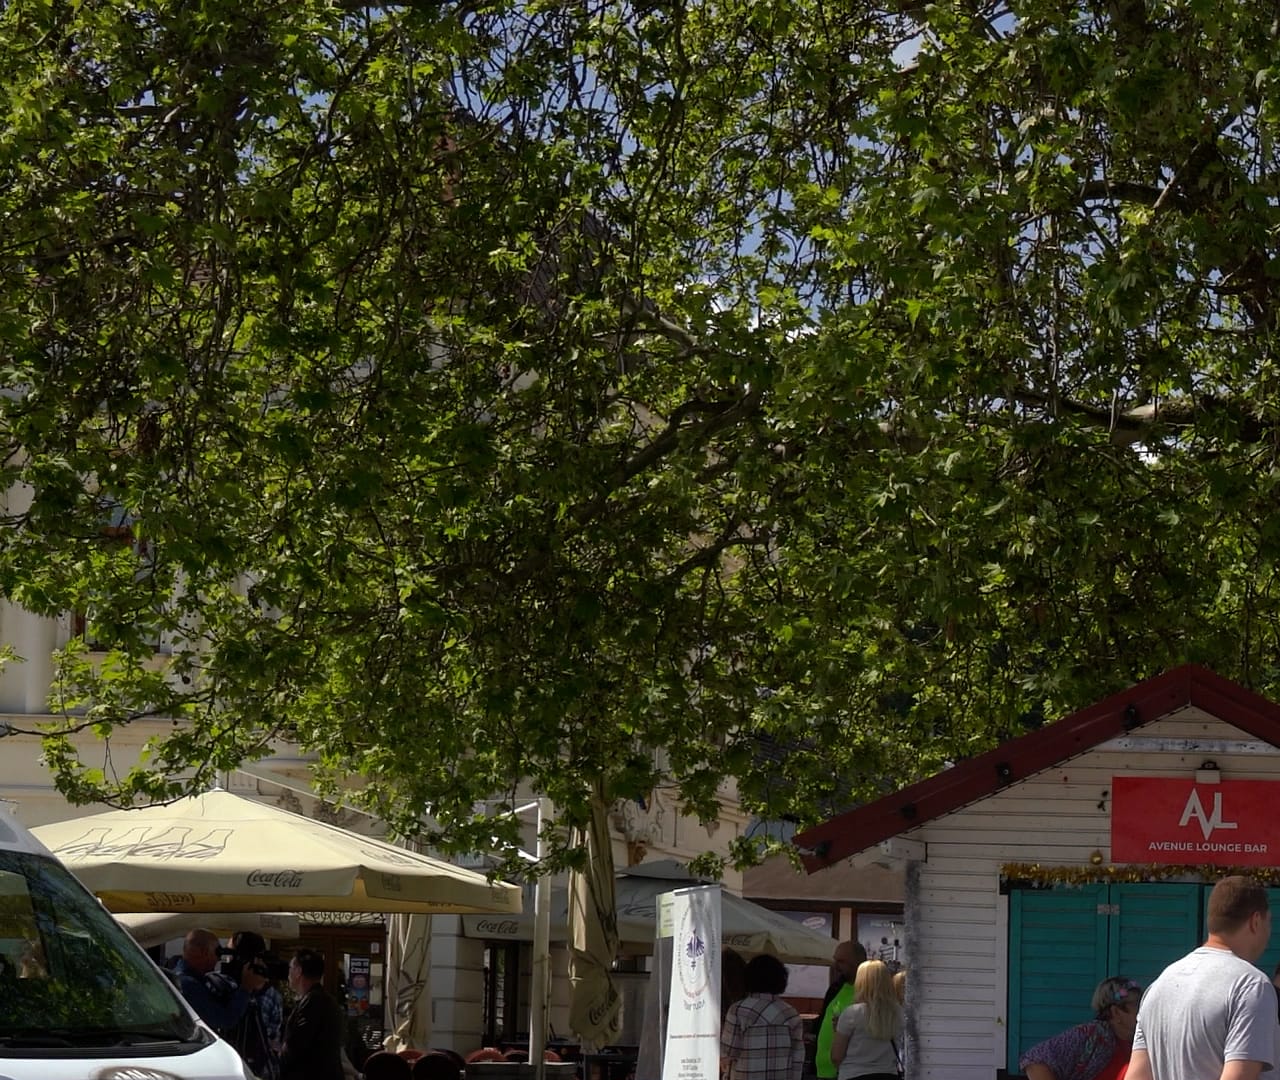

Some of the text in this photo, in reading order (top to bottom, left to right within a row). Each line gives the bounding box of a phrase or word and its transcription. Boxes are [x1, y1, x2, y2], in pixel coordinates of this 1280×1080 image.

[1148, 841, 1268, 853] AVENUE LOUNGE BAR
